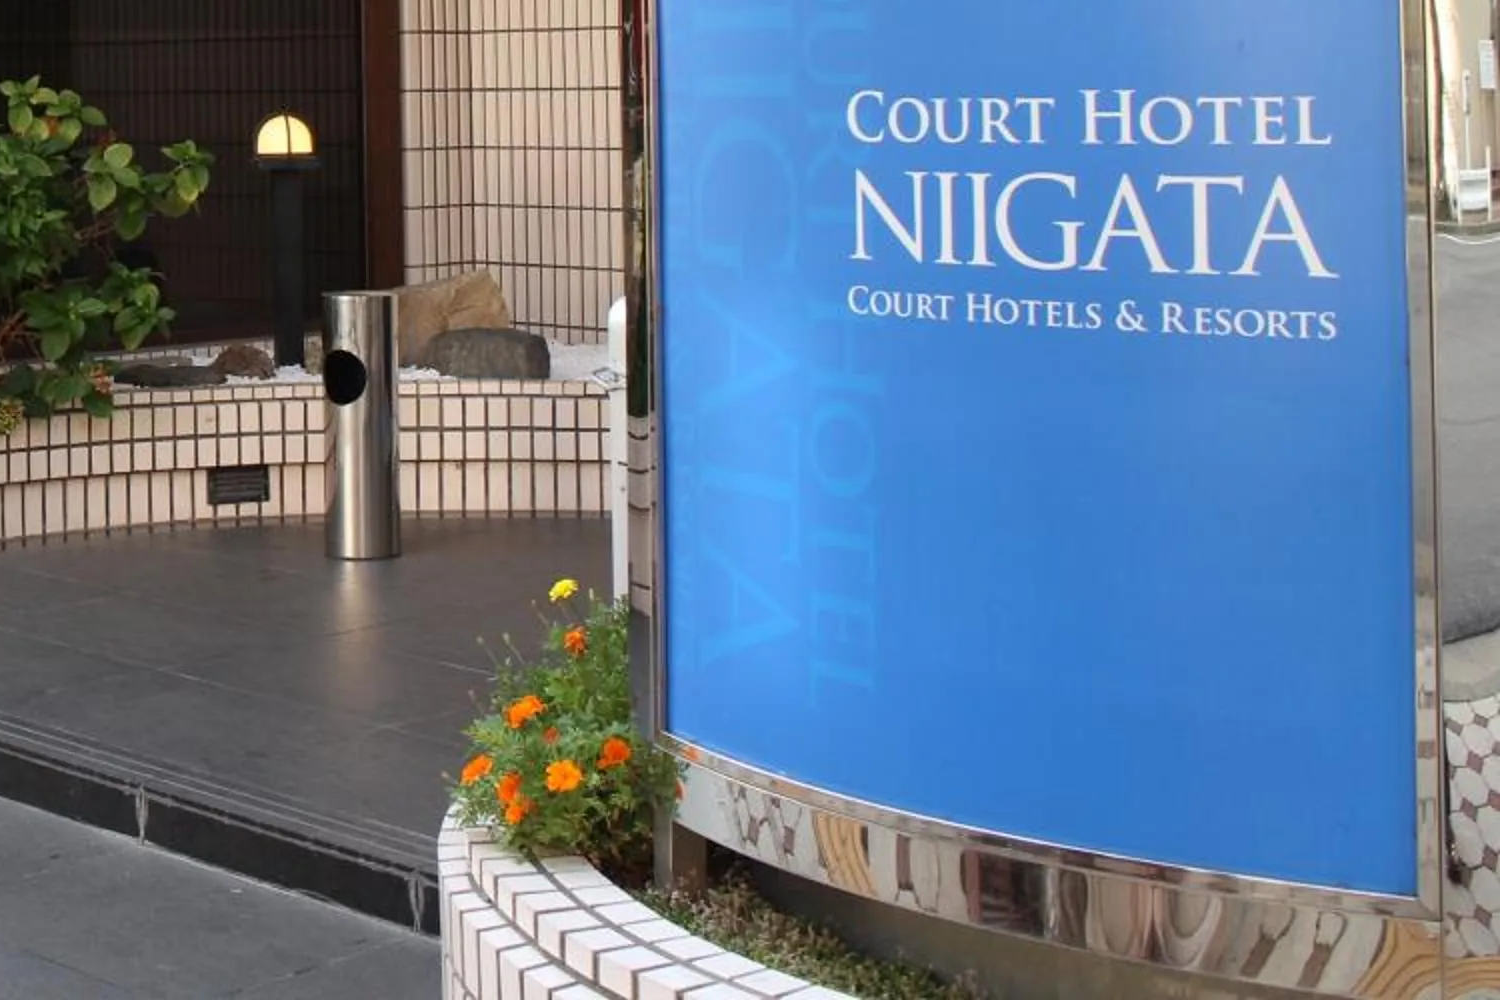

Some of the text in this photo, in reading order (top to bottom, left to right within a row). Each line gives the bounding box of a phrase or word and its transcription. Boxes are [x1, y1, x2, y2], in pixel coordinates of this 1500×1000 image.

[846, 88, 1333, 146] COURT HOTEL
[850, 169, 1339, 279] NIIGATA
[847, 285, 1338, 340] COURT HOTELS & RESORTS
